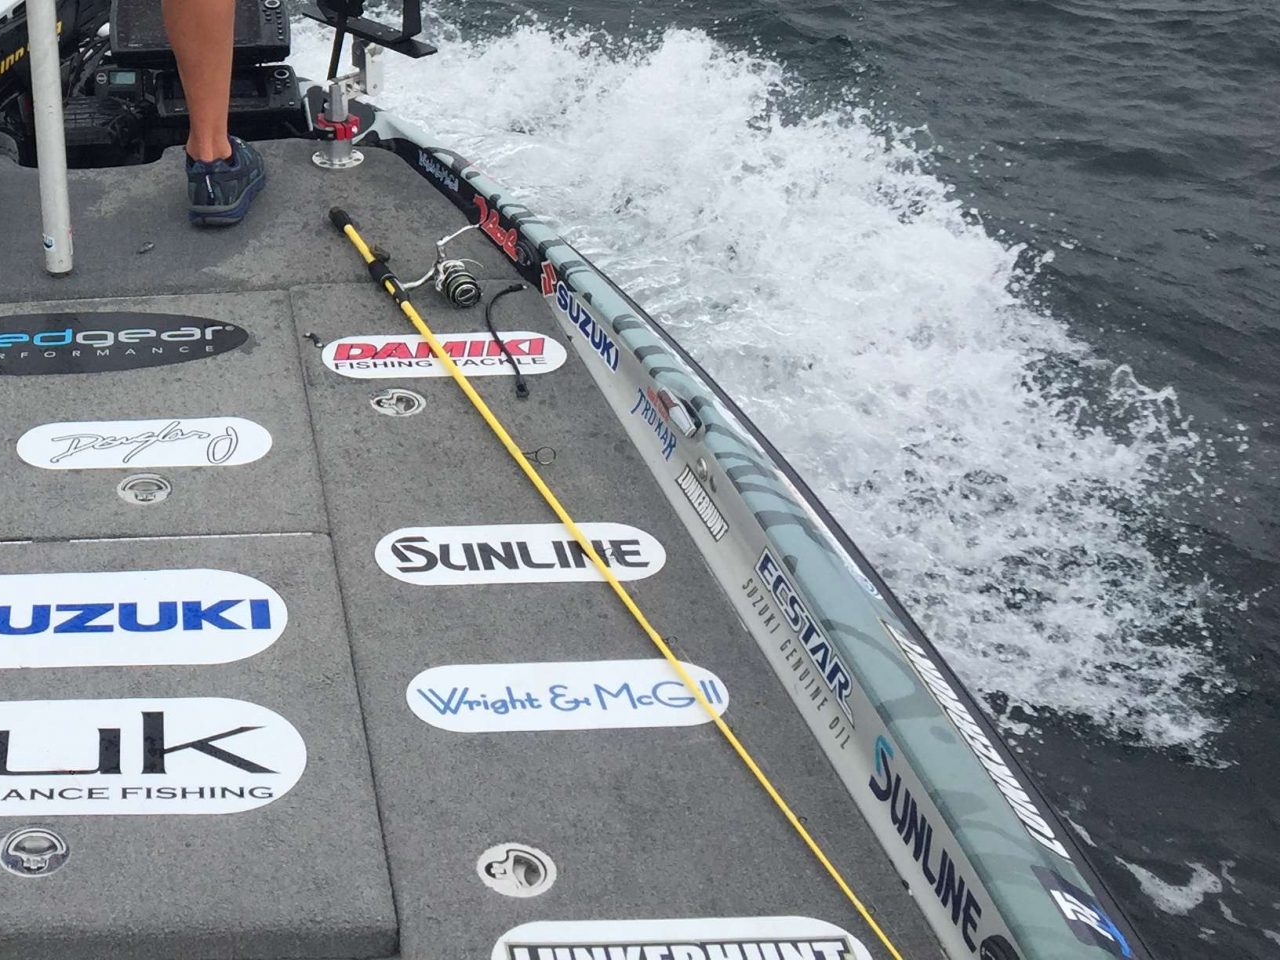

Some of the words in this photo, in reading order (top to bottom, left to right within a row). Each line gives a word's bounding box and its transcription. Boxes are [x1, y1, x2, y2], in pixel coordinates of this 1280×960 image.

[332, 337, 545, 362] DAMIKI
[556, 281, 620, 374] SUZUKI
[334, 358, 433, 371] FISHING
[630, 388, 677, 462] TROKAR
[391, 536, 650, 573] SUNLINE
[757, 551, 853, 718] ECSTAR
[742, 577, 780, 634] SUZUKI
[780, 637, 827, 712] GENUINE
[828, 714, 851, 750] OIL
[417, 685, 542, 716] Wright
[594, 680, 723, 710] McGll
[121, 786, 276, 800] FISHING
[869, 737, 983, 954] SUNLINE
